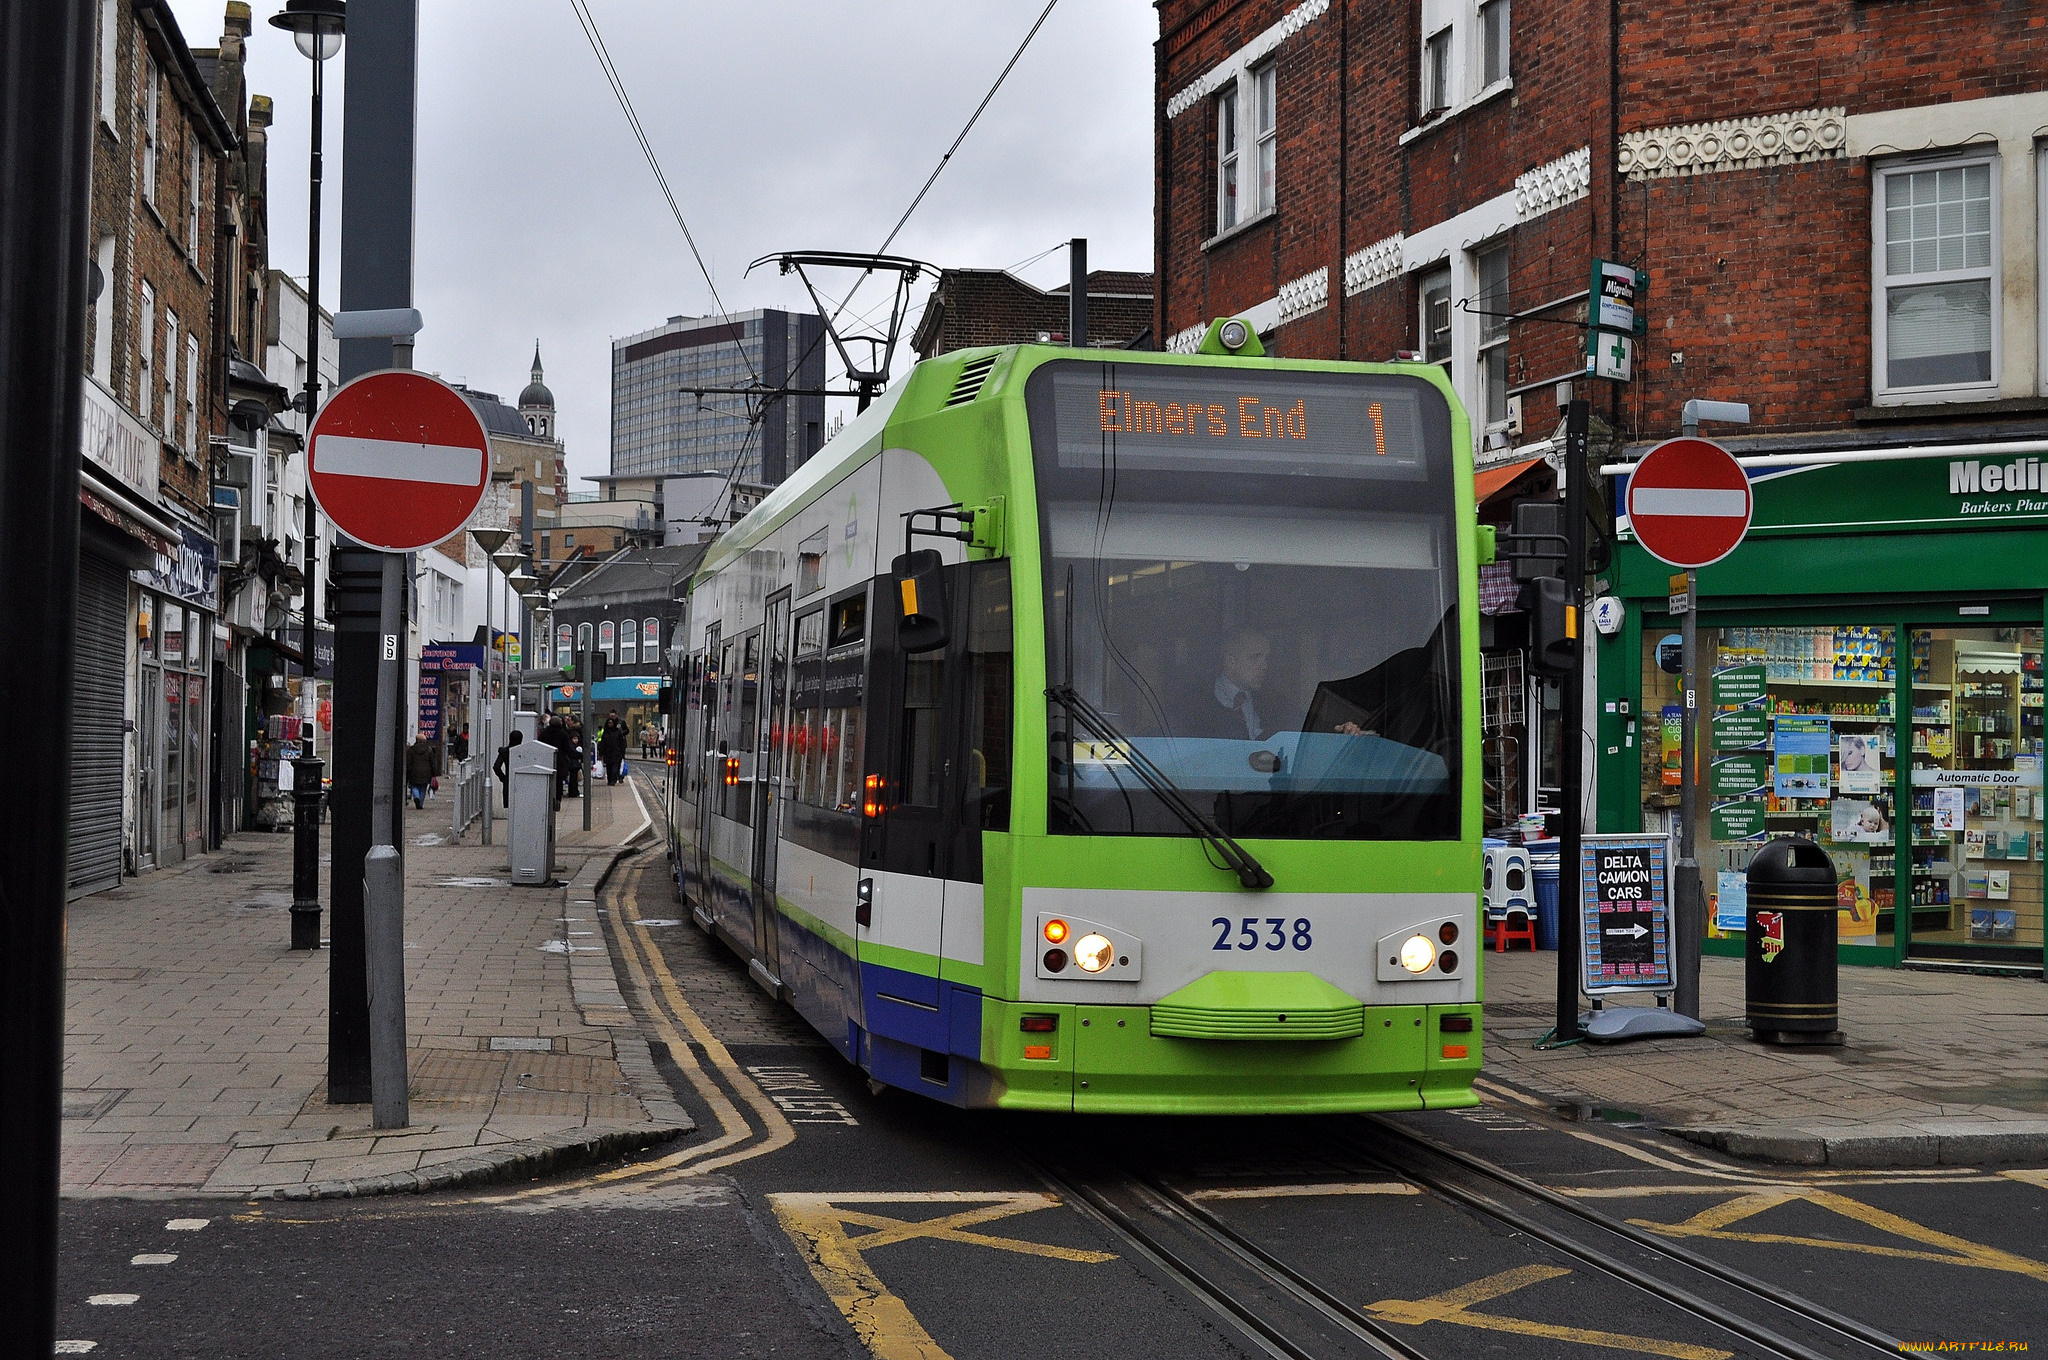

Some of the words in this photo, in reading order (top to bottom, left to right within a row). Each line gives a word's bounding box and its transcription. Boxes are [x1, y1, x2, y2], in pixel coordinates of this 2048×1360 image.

[1099, 390, 1228, 437] Elmers
[1238, 396, 1307, 440] End
[1368, 402, 1386, 455] 1
[1960, 501, 2012, 515] Barkers
[1936, 772, 1990, 783] Automatic
[1993, 773, 2019, 783] Door
[1604, 856, 1643, 869] DELTA
[1599, 870, 1650, 884] CANNON
[1608, 886, 1643, 900] CARS
[1211, 917, 1314, 952] 2538
